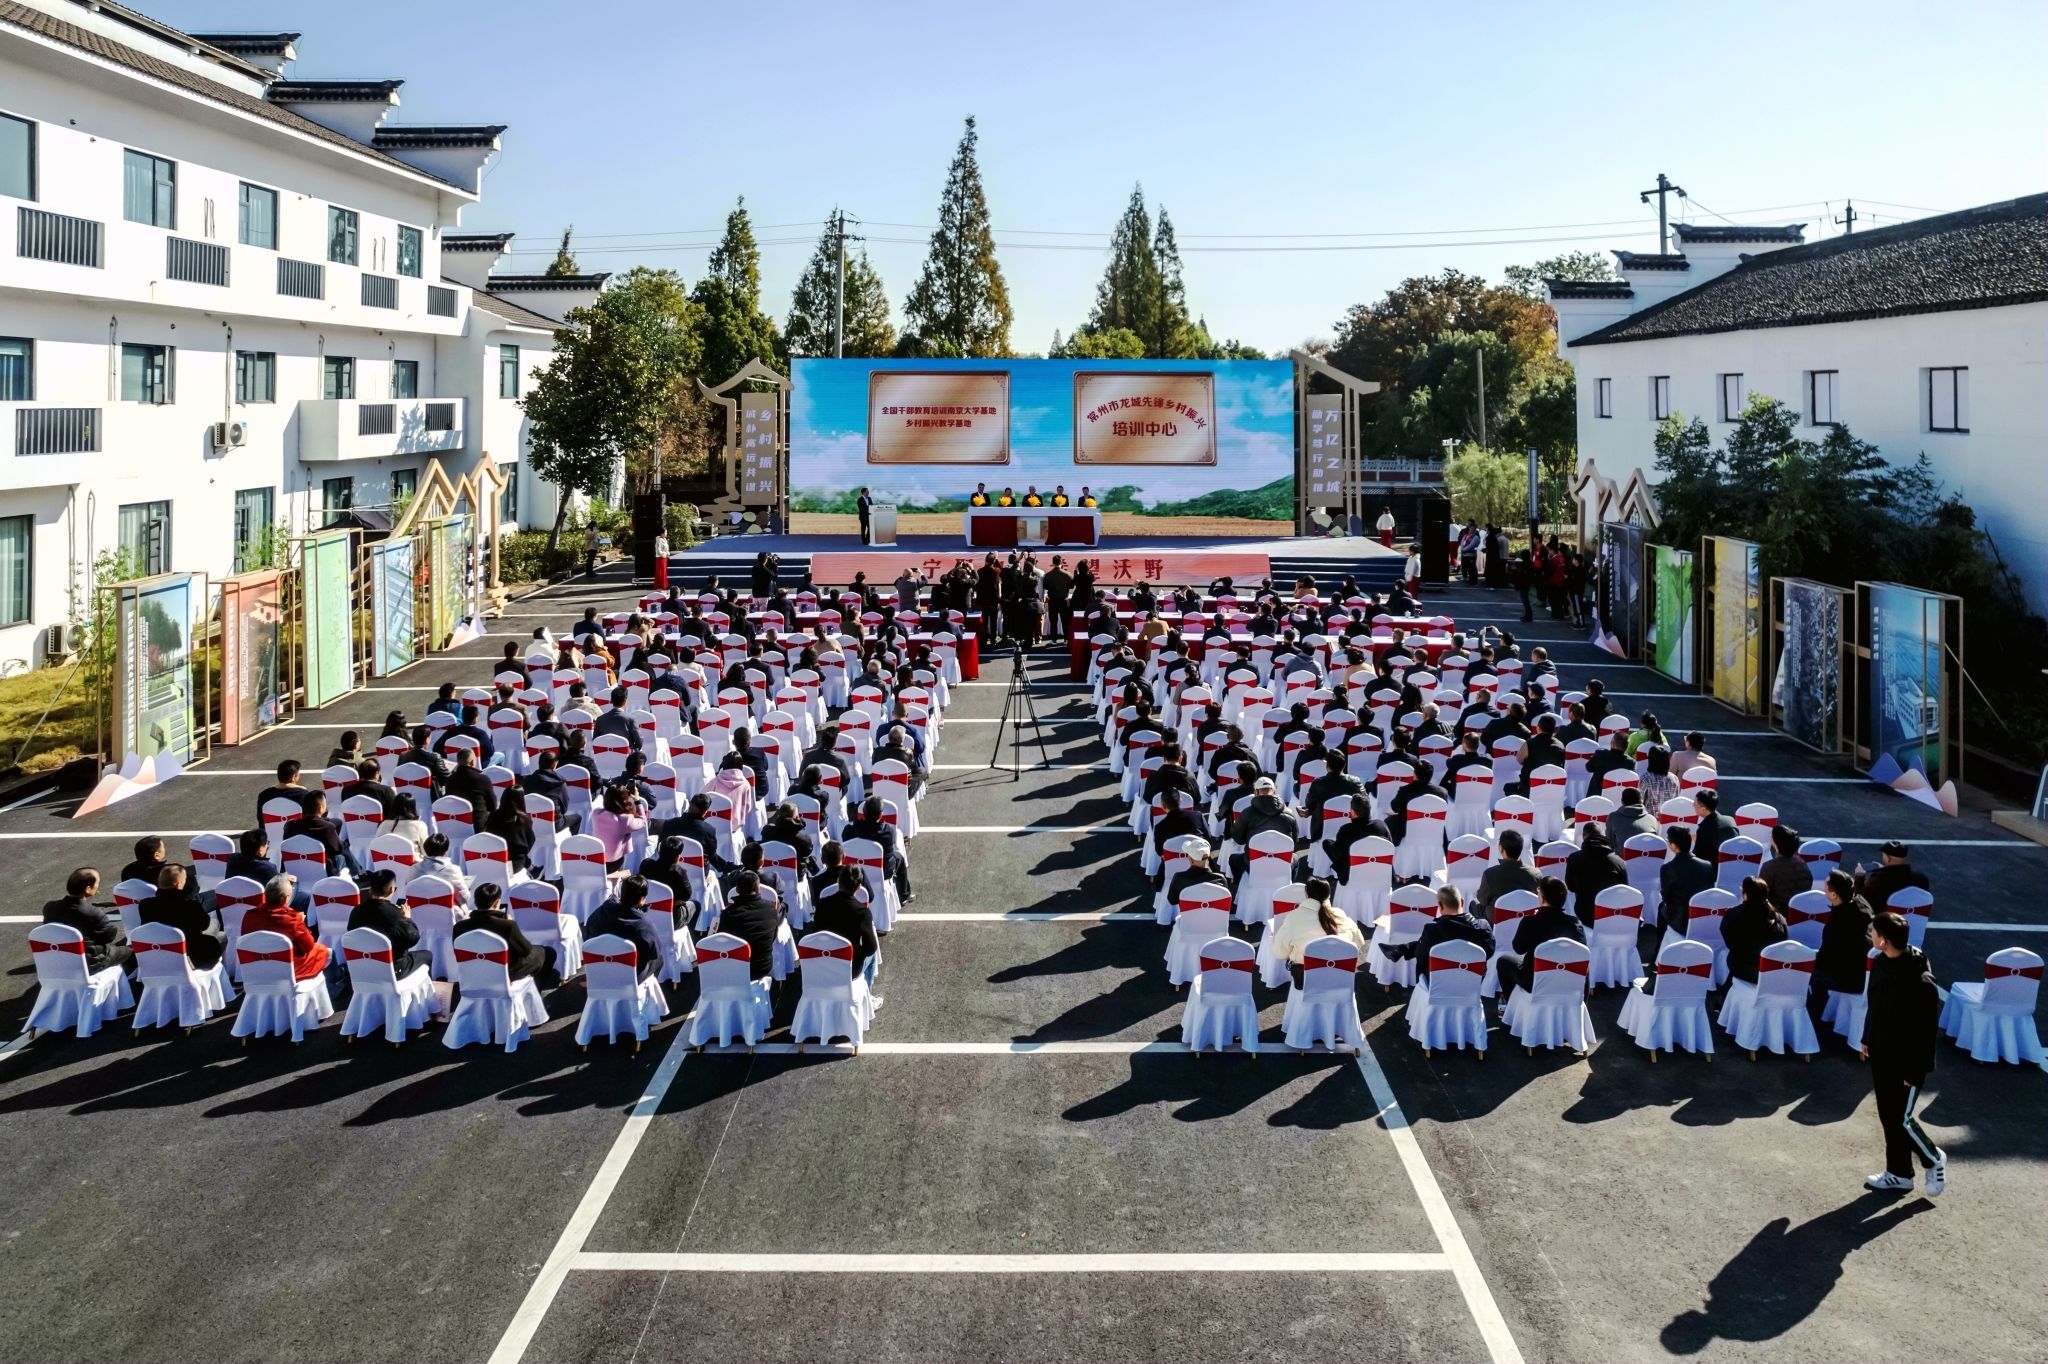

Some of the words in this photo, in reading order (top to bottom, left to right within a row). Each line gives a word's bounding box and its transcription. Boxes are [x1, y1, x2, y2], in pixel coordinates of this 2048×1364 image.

[882, 406, 997, 415] 全国干部教育培训南京大学基地
[1087, 396, 1207, 430] 常州市龙城先锋乡村振兴
[905, 419, 972, 428] 乡村振兴教学基地
[1112, 421, 1177, 437] 培训中心
[759, 410, 772, 491] 乡村振兴
[1325, 410, 1340, 493] 万亿之城
